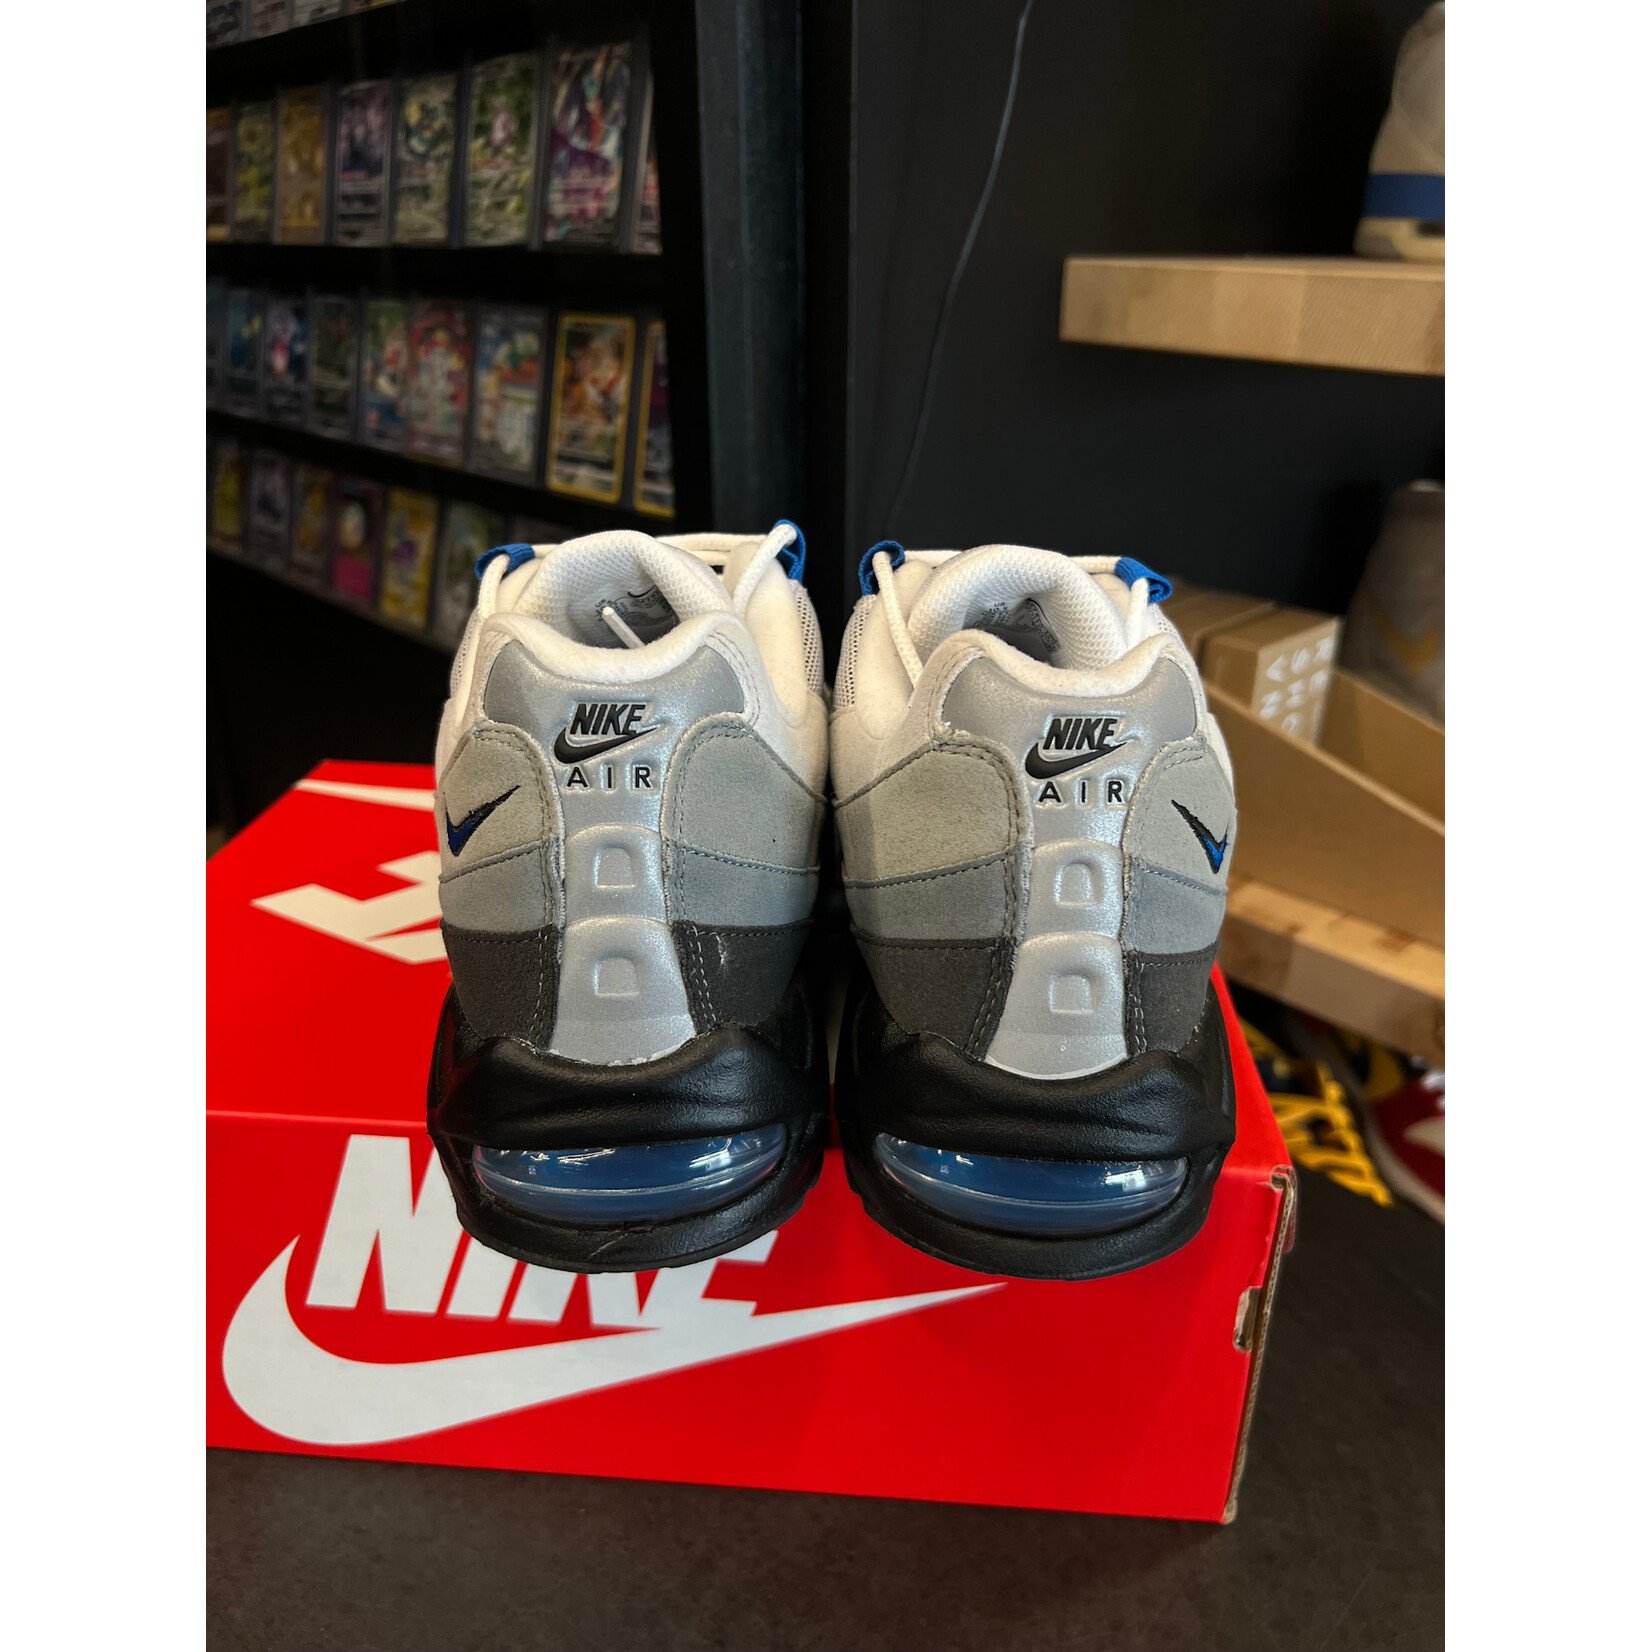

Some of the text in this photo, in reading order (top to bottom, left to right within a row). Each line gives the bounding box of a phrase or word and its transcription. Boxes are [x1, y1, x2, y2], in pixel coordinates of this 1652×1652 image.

[569, 703, 646, 736] NIKE
[1042, 718, 1118, 751] NIKE
[566, 766, 652, 789] AIR
[1038, 781, 1123, 803] AIR
